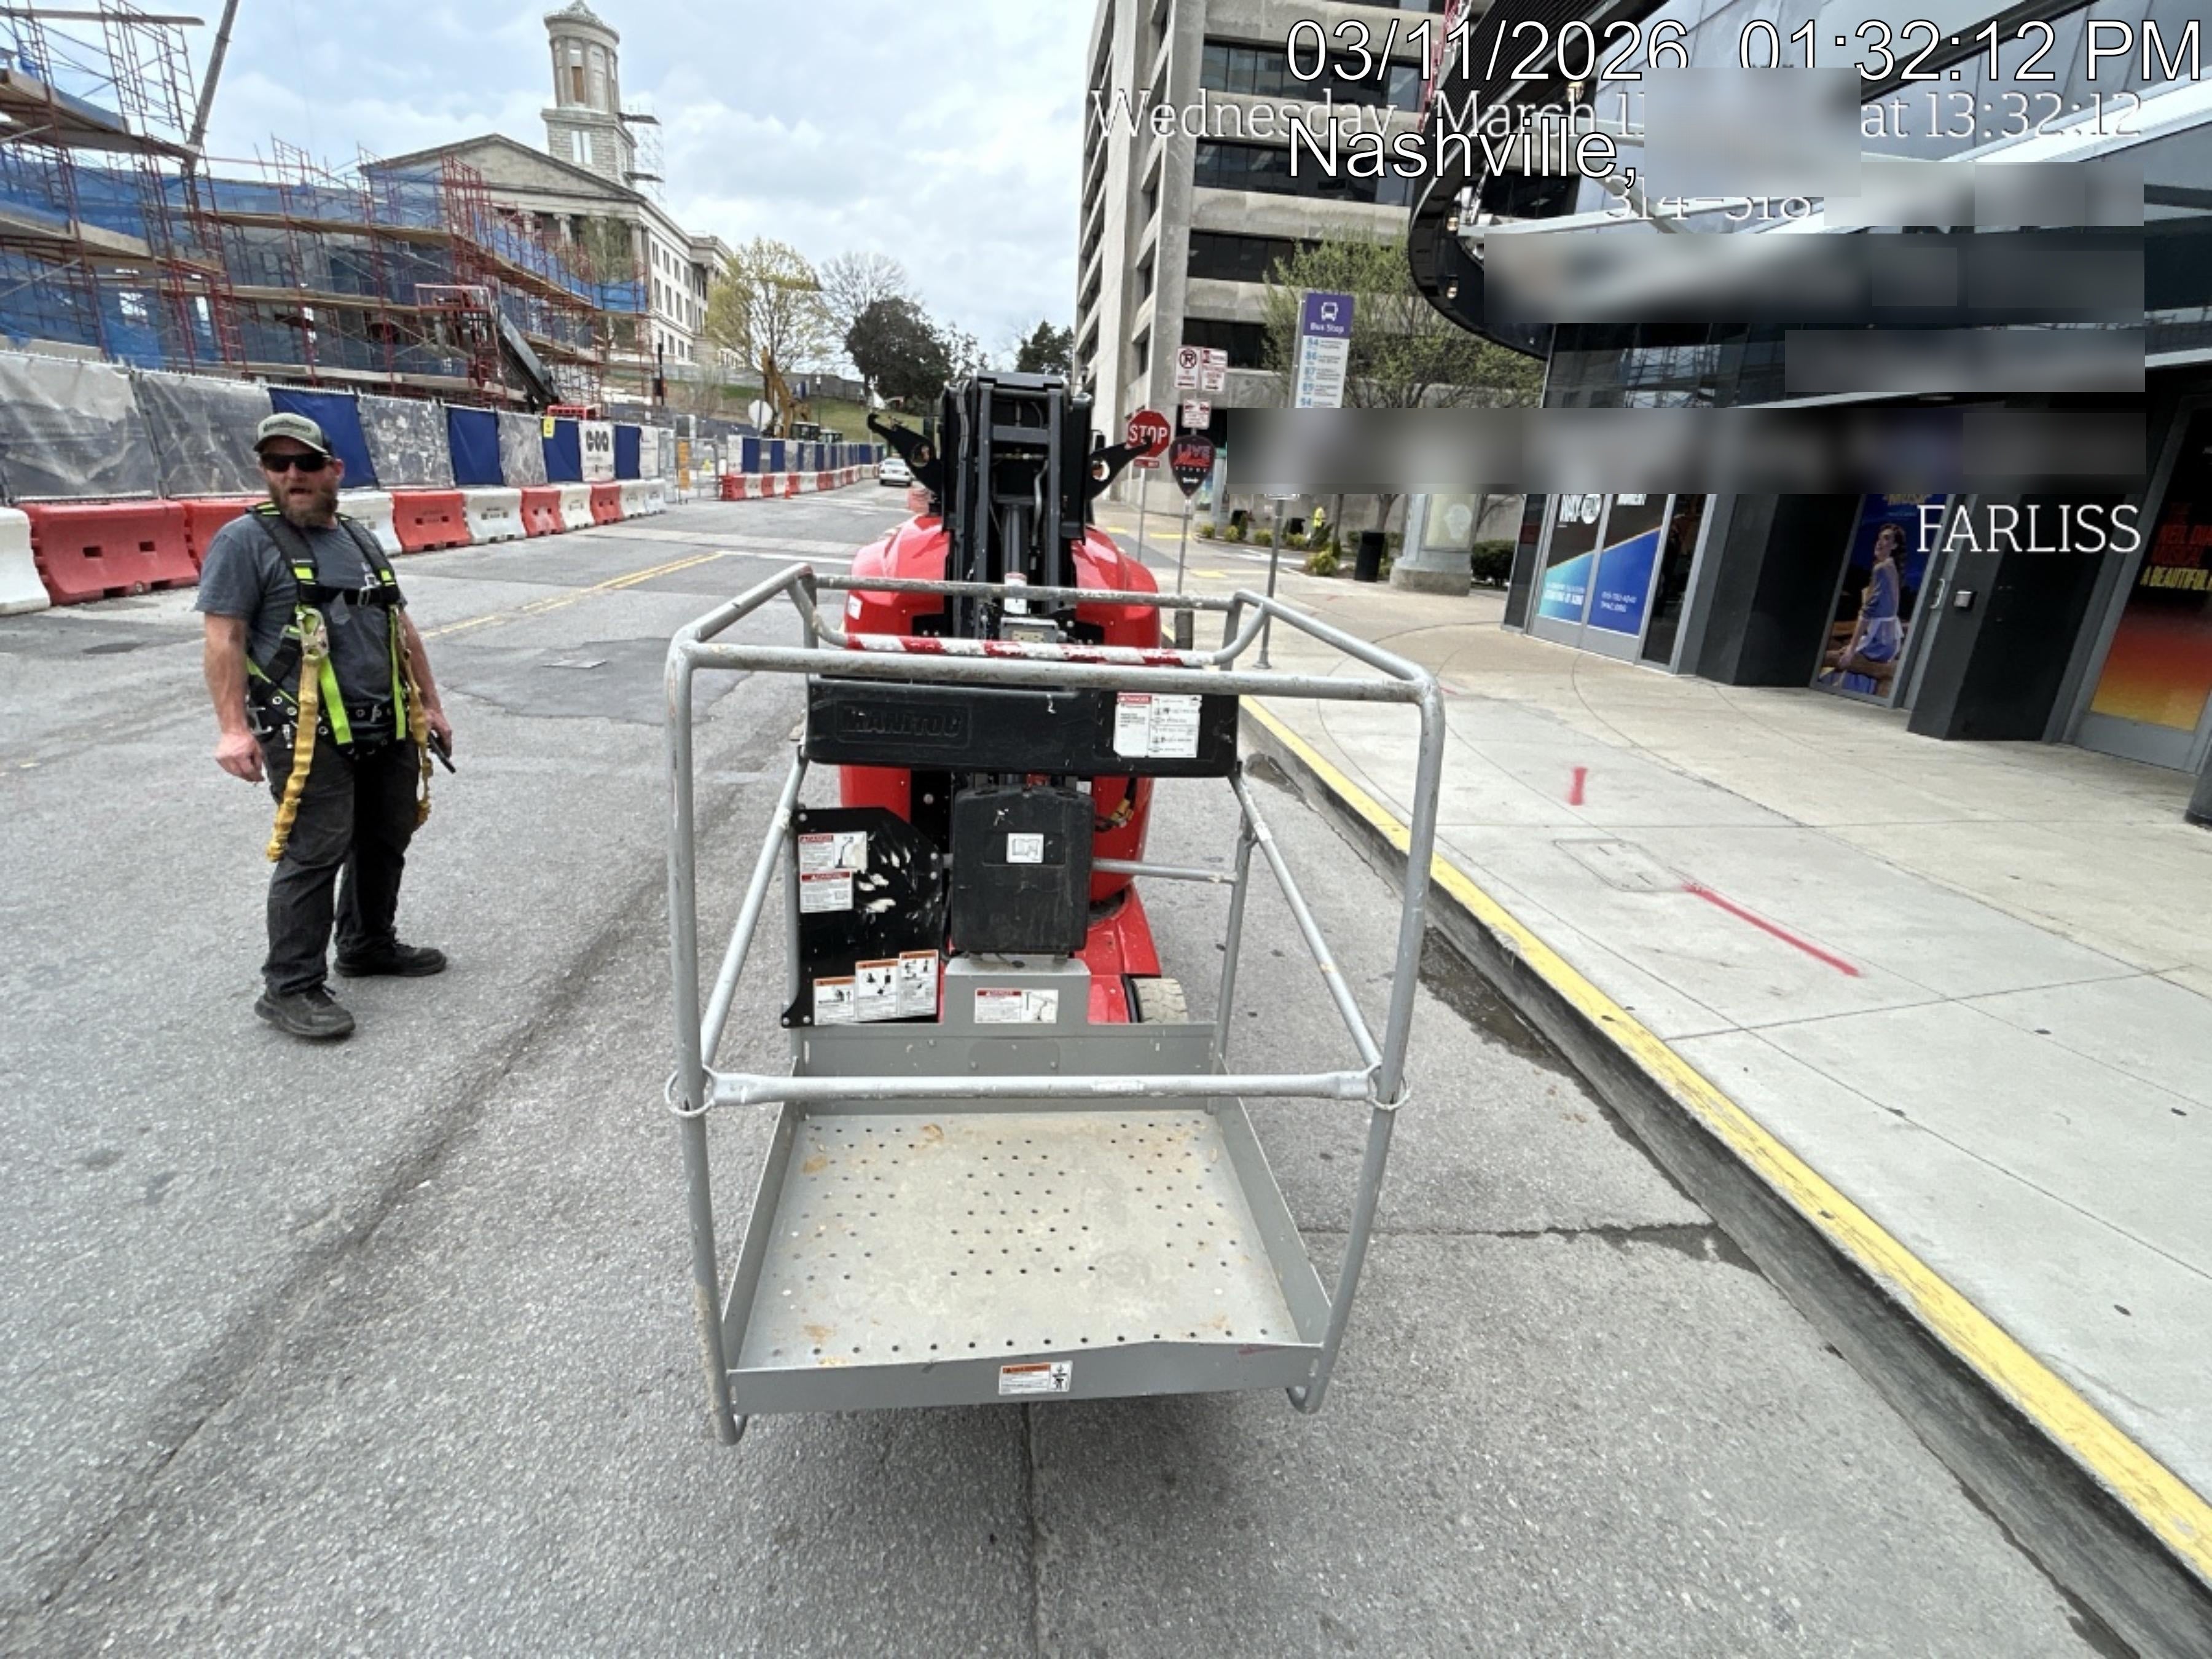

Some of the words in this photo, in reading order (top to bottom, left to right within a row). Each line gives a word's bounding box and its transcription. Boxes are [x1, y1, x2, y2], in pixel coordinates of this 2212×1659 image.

[1309, 321, 1325, 331] Bus
[1327, 323, 1344, 334] Stop
[1129, 425, 1167, 444] STOP
